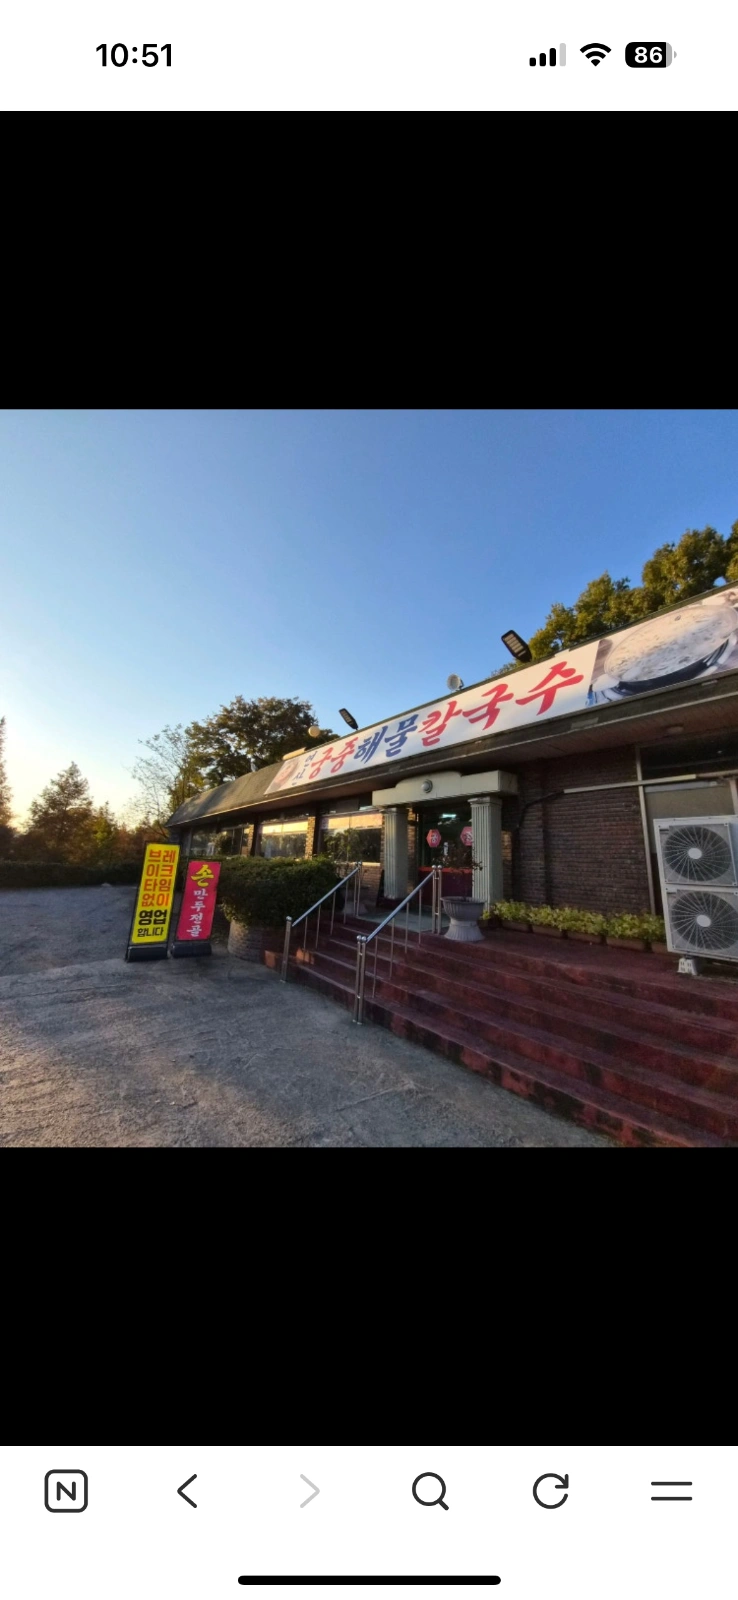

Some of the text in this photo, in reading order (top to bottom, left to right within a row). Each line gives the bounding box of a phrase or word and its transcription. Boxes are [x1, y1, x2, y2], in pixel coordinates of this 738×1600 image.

[148, 849, 176, 863] 브레
[146, 864, 174, 877] 이크
[143, 878, 172, 892] 타임
[141, 893, 169, 907] 없이
[138, 909, 168, 925] 영업
[137, 927, 164, 938] 합니다
